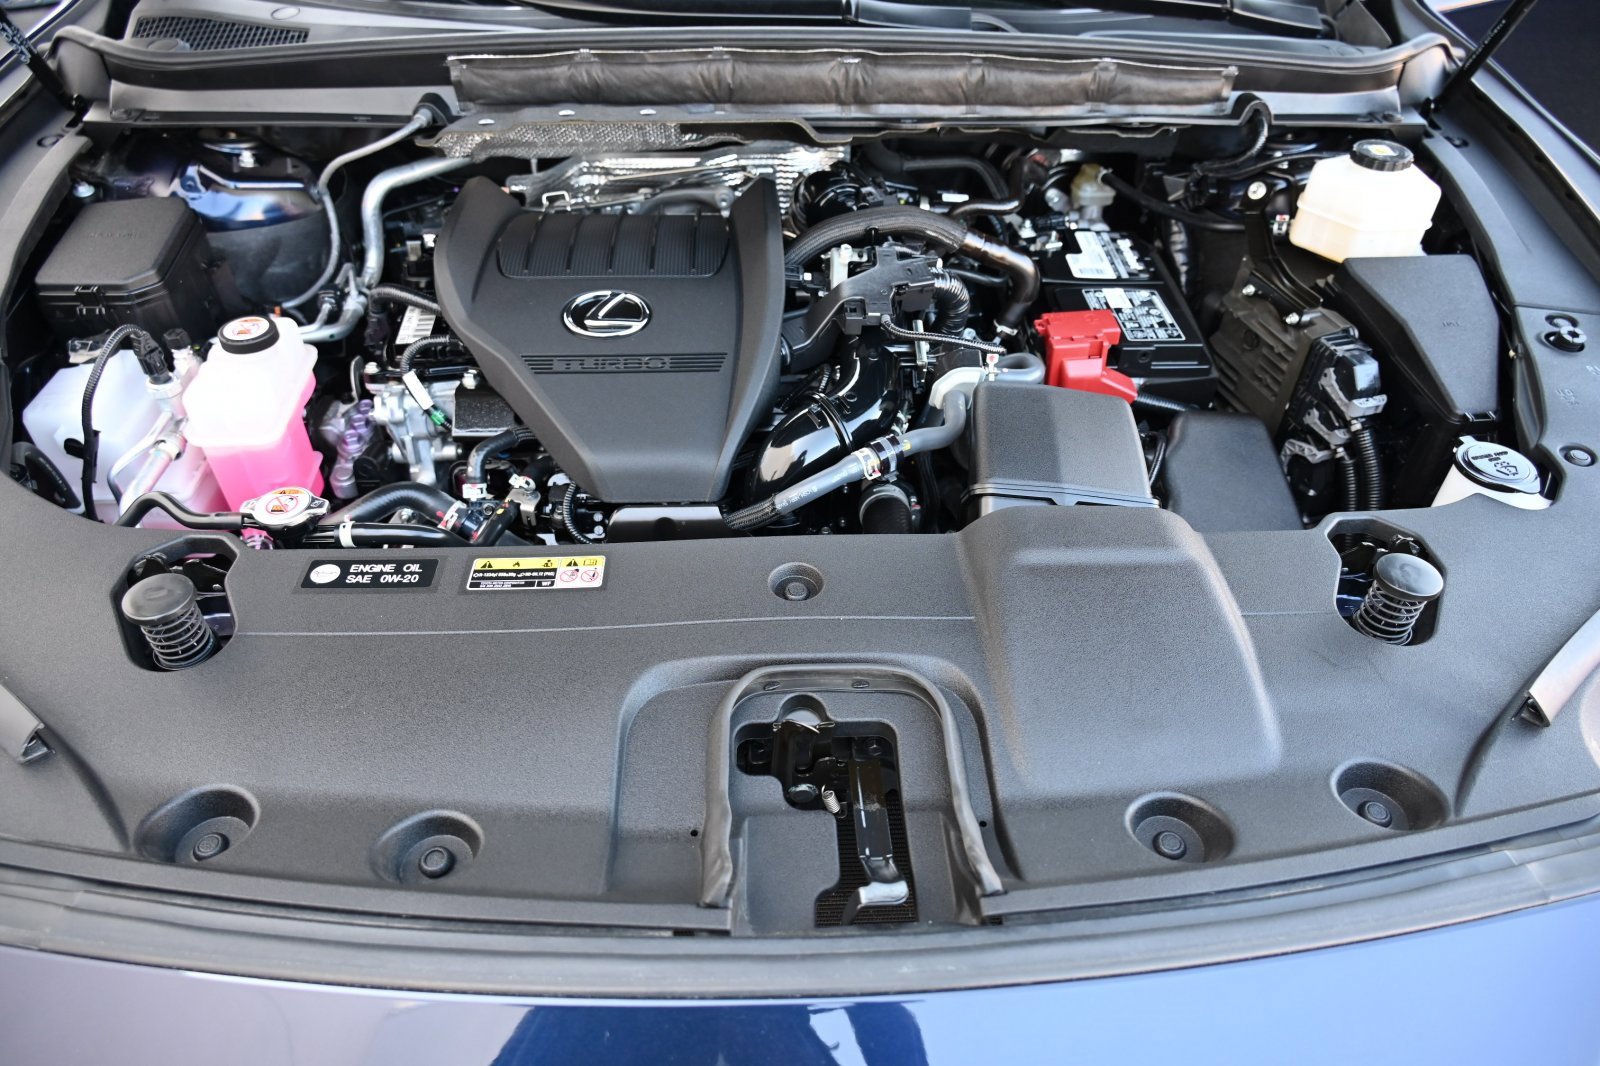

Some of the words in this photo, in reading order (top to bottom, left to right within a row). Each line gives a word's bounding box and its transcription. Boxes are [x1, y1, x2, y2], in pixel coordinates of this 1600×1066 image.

[556, 357, 667, 370] TURBO
[349, 563, 397, 573] ENGINE
[402, 563, 423, 572] OIL
[345, 574, 373, 583] SAE
[380, 574, 419, 583] 0W-20
